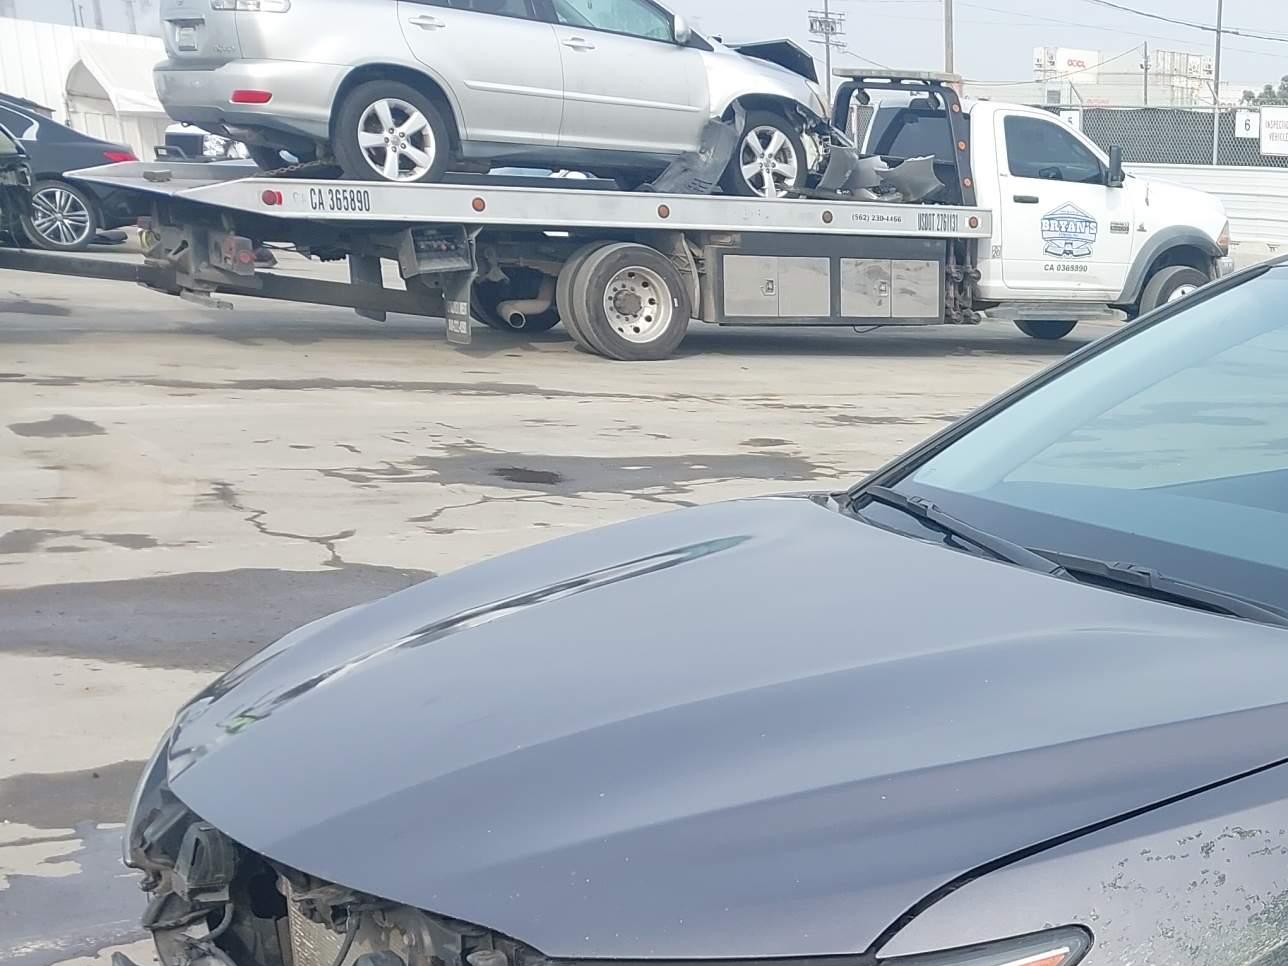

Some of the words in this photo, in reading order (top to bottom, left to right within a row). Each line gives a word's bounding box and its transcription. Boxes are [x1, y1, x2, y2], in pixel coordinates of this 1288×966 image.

[1244, 118, 1251, 132] 6
[309, 187, 325, 211] CA
[328, 188, 370, 212] 365890
[1041, 219, 1098, 234] BRYAN'S
[1043, 263, 1055, 272] CA
